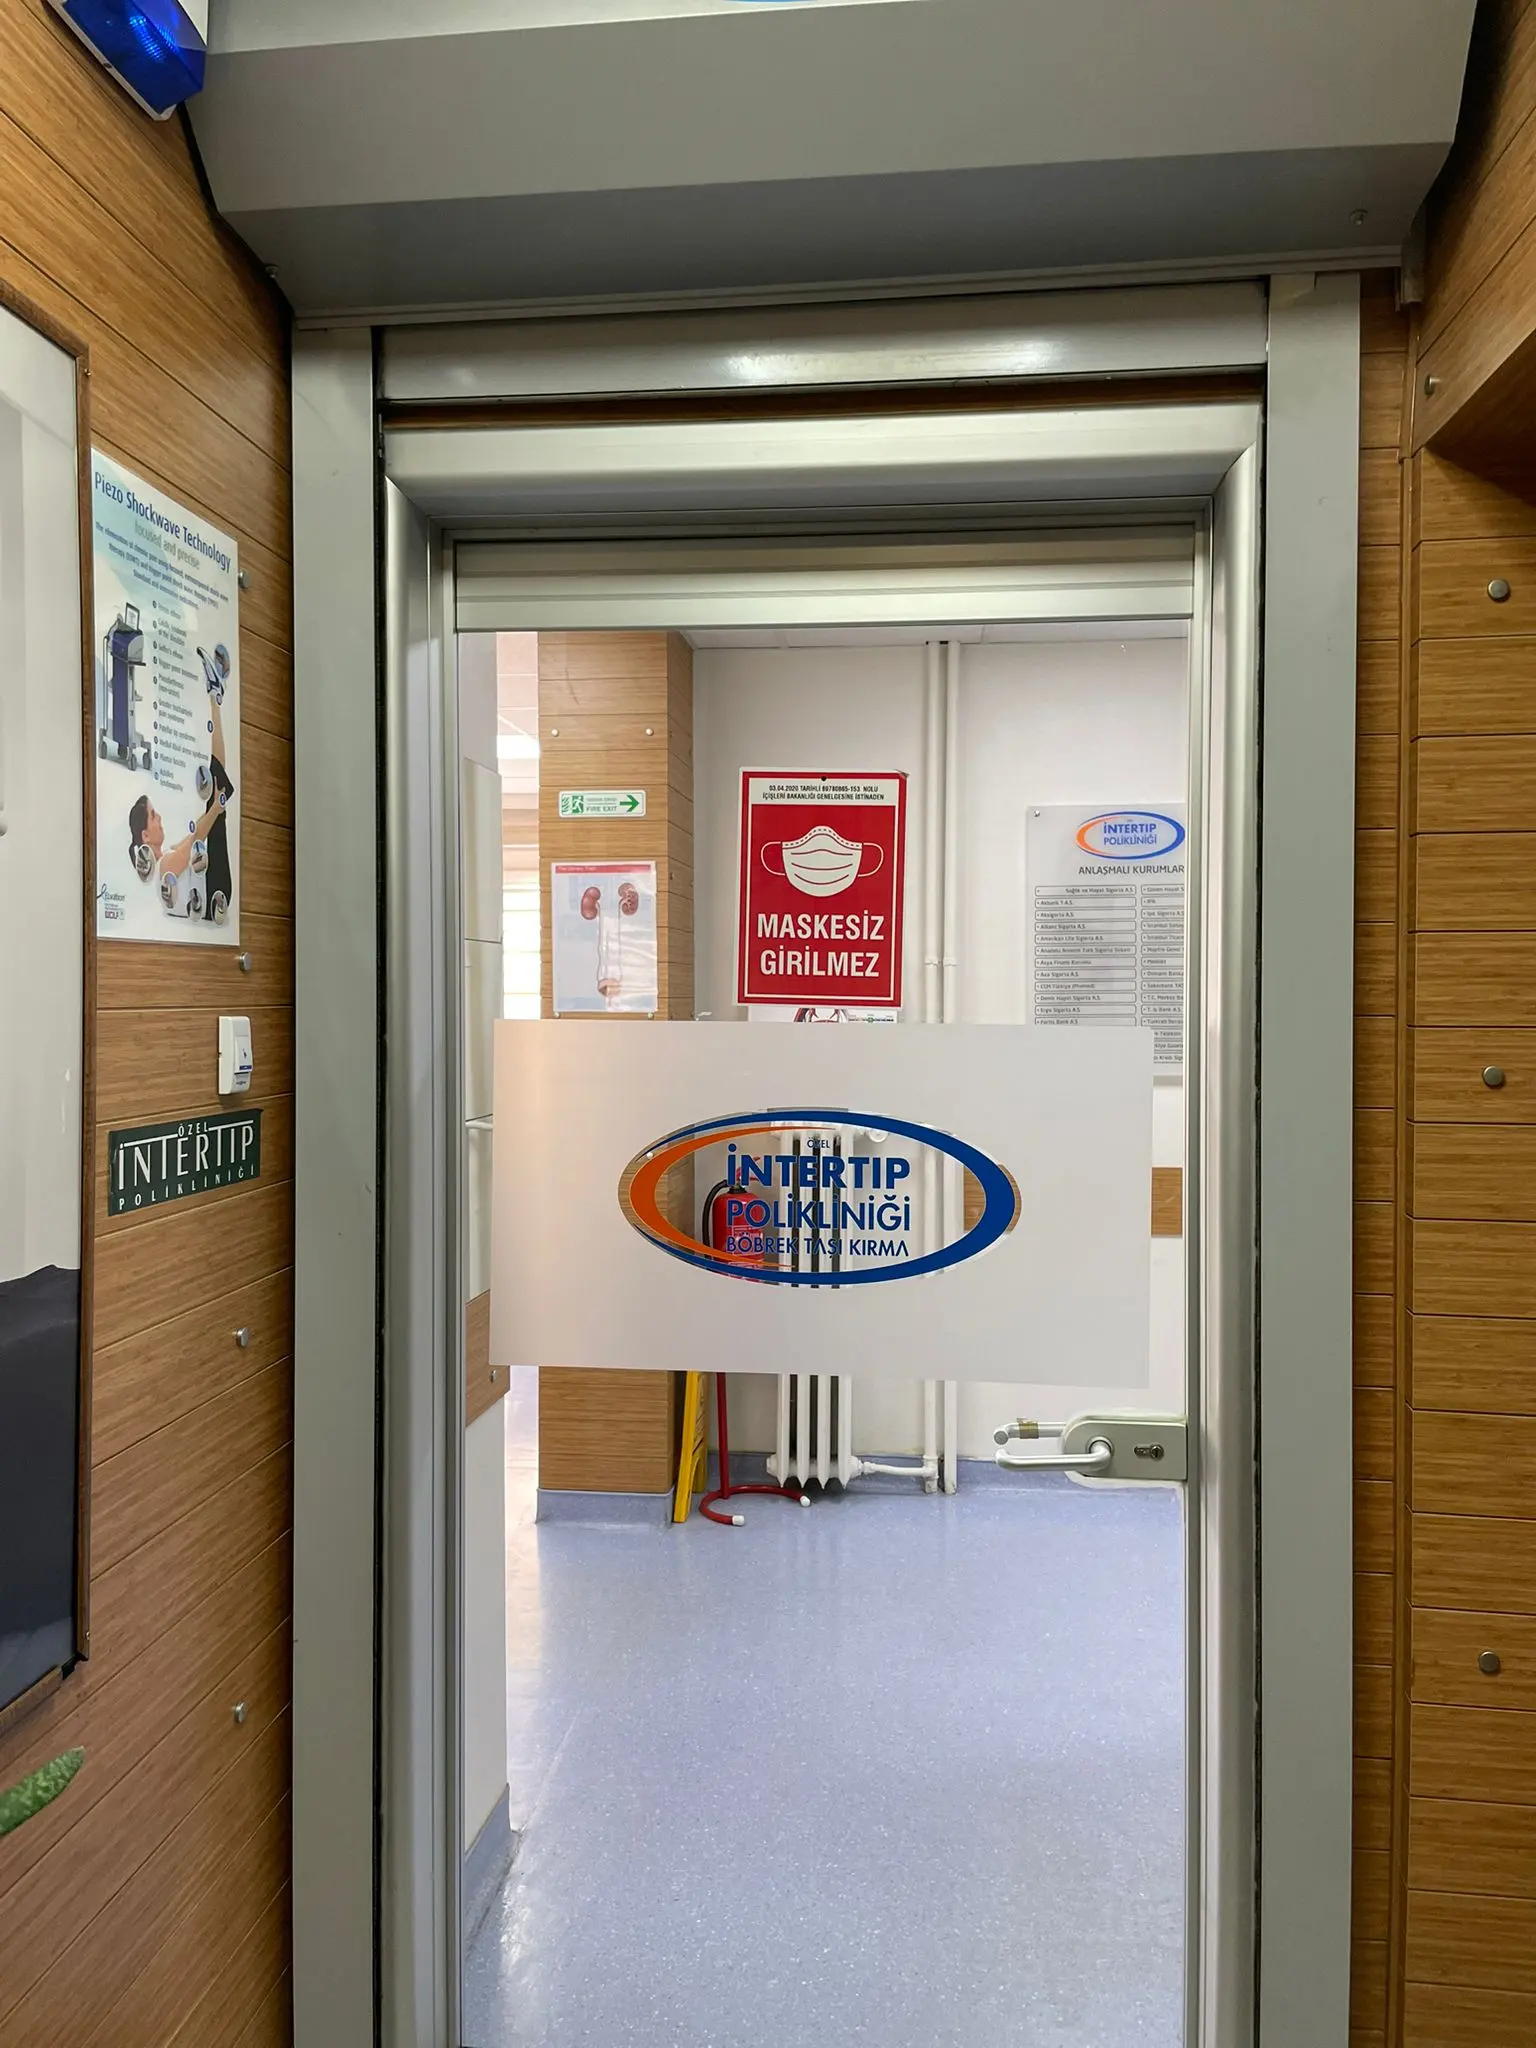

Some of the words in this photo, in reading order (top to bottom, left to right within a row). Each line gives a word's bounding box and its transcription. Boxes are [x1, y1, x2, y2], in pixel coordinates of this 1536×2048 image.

[95, 471, 123, 504] Piezo
[126, 491, 180, 539] Shockwave
[183, 526, 231, 573] Technology
[134, 518, 162, 548] focused
[164, 540, 176, 555] and
[786, 792, 816, 800] BAKANLIĞI
[854, 793, 885, 801] İSTİNADEN
[1103, 822, 1157, 834] İNTERTIP
[1103, 834, 1157, 845] POLİKLİNİĞİ
[1078, 865, 1130, 876] ANLAŞMALI
[1133, 864, 1185, 874] KURUMLAR
[757, 910, 884, 940] MASKESİZ
[760, 945, 880, 977] GİRİLMEZ
[178, 1121, 209, 1137] ÖZEL
[806, 1136, 830, 1149] ÖZEL
[727, 1143, 911, 1190] İNTERTIP
[727, 1193, 911, 1232] POLİKLİNİĞİ
[727, 1232, 799, 1255] BÖBREK
[803, 1237, 843, 1259] TAŞI
[849, 1237, 909, 1258] KIRMA
